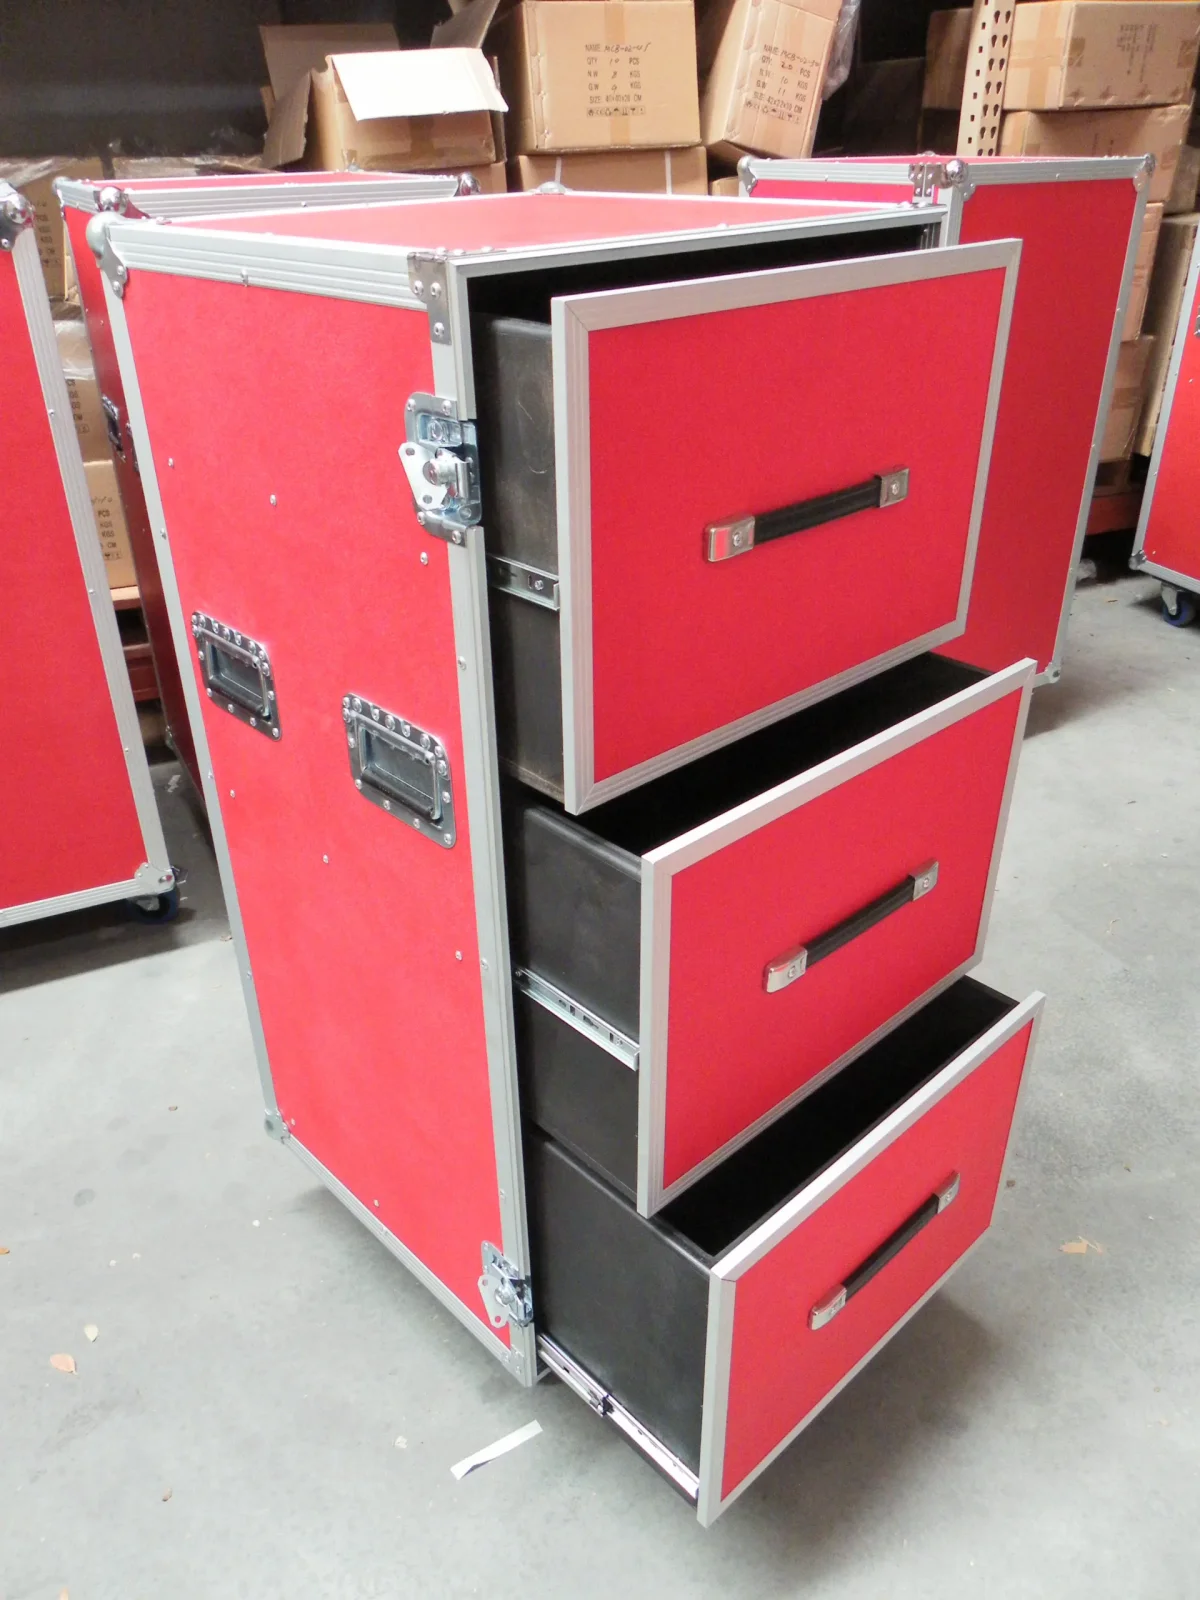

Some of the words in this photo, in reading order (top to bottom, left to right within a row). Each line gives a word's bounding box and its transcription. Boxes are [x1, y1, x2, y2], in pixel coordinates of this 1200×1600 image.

[629, 57, 640, 65] PCS
[629, 70, 640, 78] KGS
[800, 68, 811, 78] PCS
[630, 81, 641, 89] KGS
[781, 76, 788, 84] 10
[797, 80, 808, 90] KGS
[633, 94, 642, 102] CM
[795, 93, 806, 102] KGS
[794, 104, 803, 114] CM
[98, 509, 110, 518] PCS
[107, 541, 117, 549] CM
